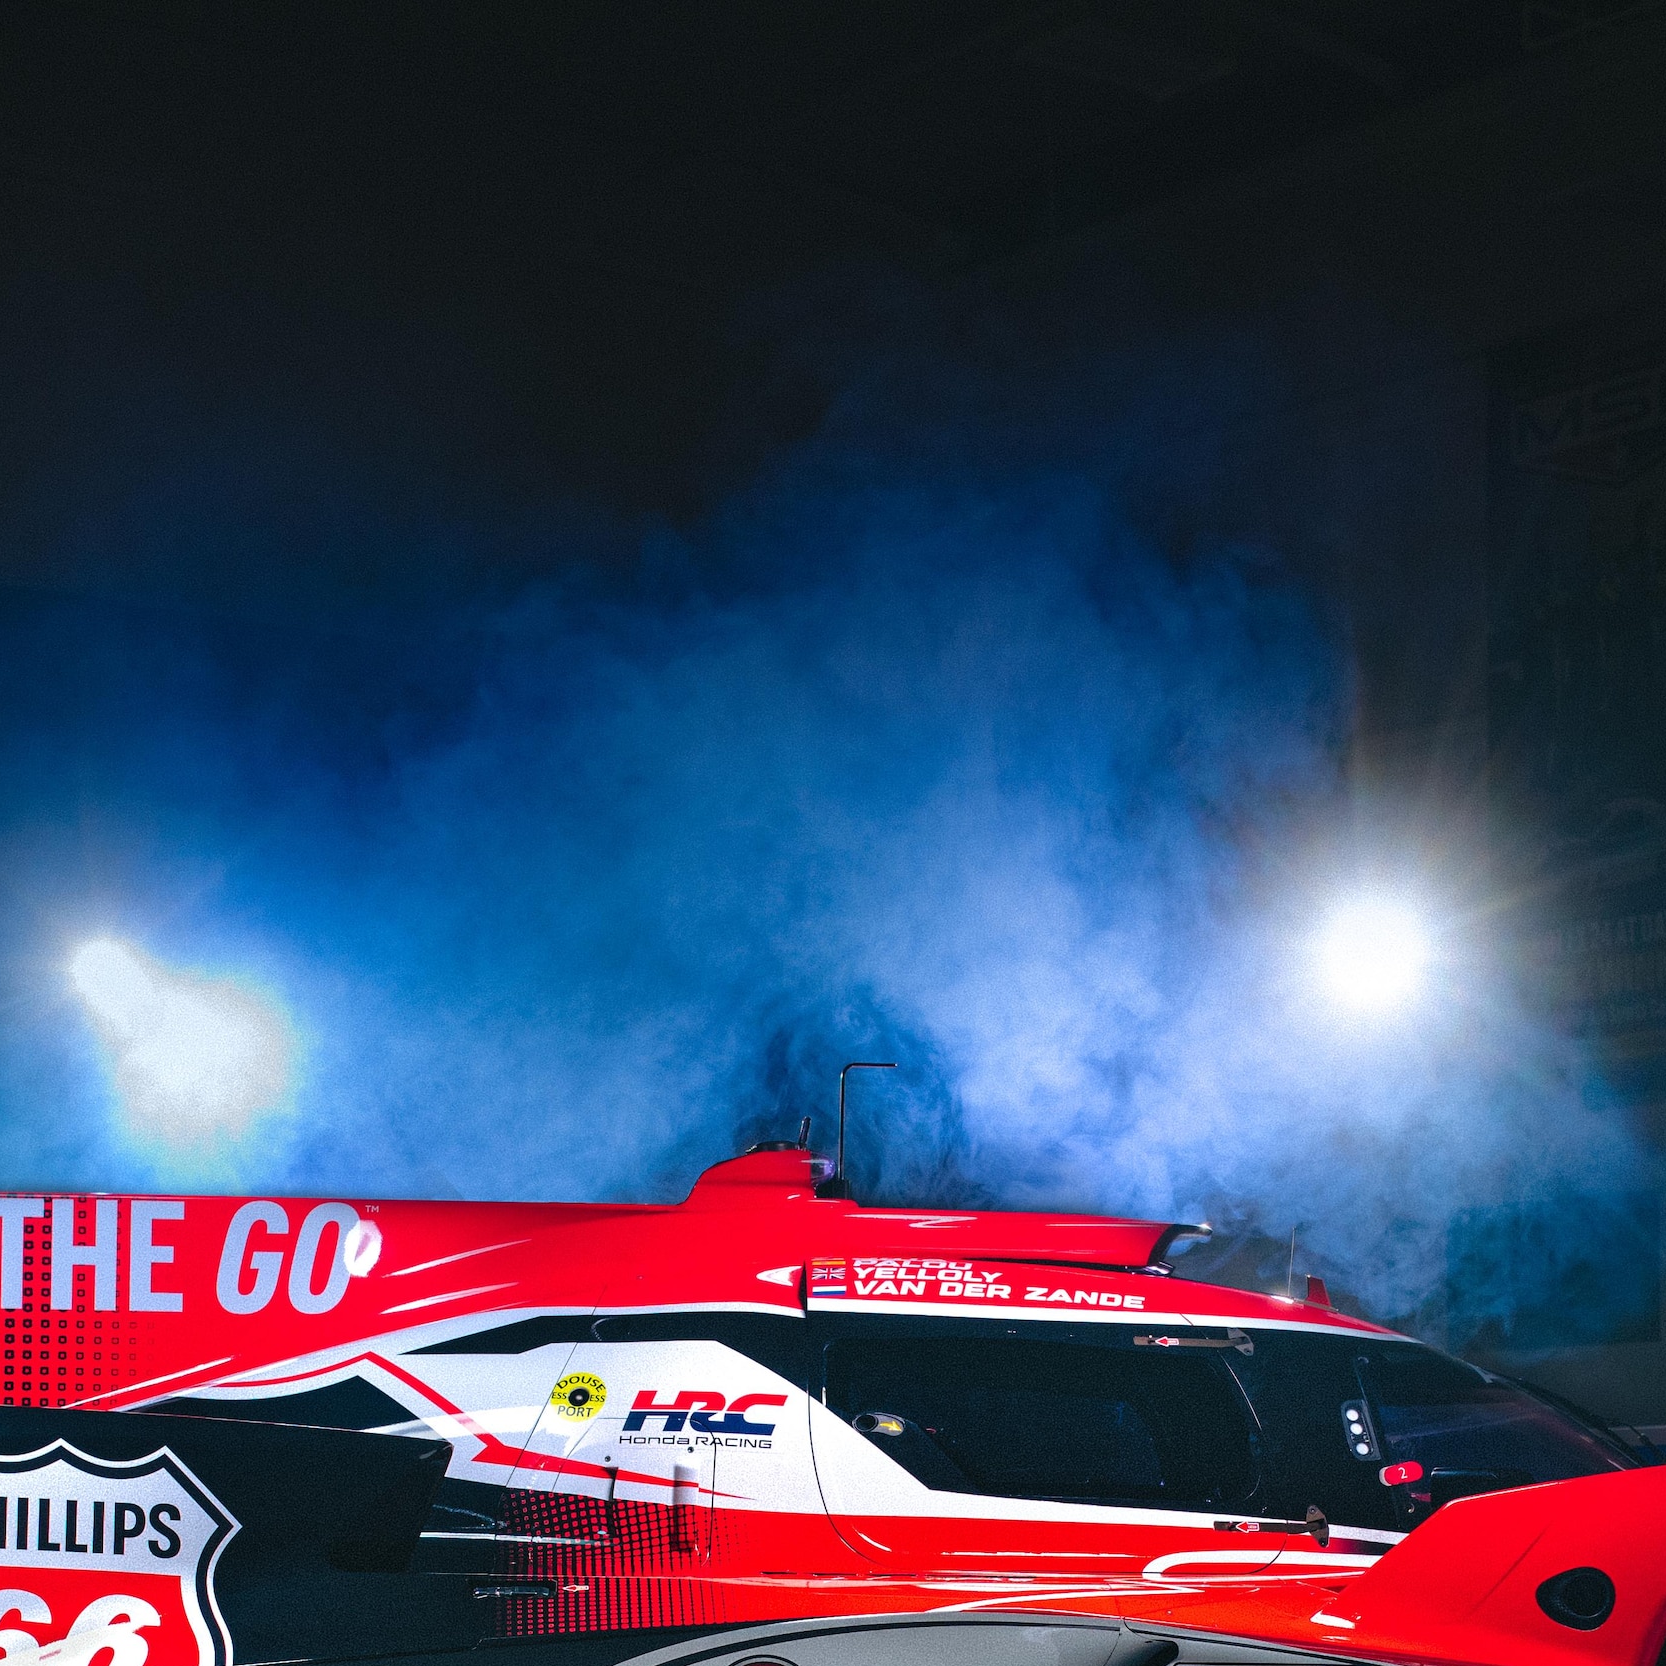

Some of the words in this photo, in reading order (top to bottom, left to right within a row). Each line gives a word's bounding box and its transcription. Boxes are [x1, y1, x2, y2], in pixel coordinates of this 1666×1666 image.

[214, 1199, 362, 1316] GO
[854, 1267, 1003, 1284] YELLOLY
[854, 1280, 926, 1297] VAN
[939, 1283, 1012, 1300] DER
[1024, 1286, 1145, 1309] ZANDE
[556, 1375, 607, 1392] DOUSE
[557, 1405, 594, 1418] PORT
[622, 1390, 789, 1436] HRC
[619, 1434, 690, 1446] Honda
[695, 1436, 773, 1449] RACING
[1397, 1466, 1408, 1480] 2
